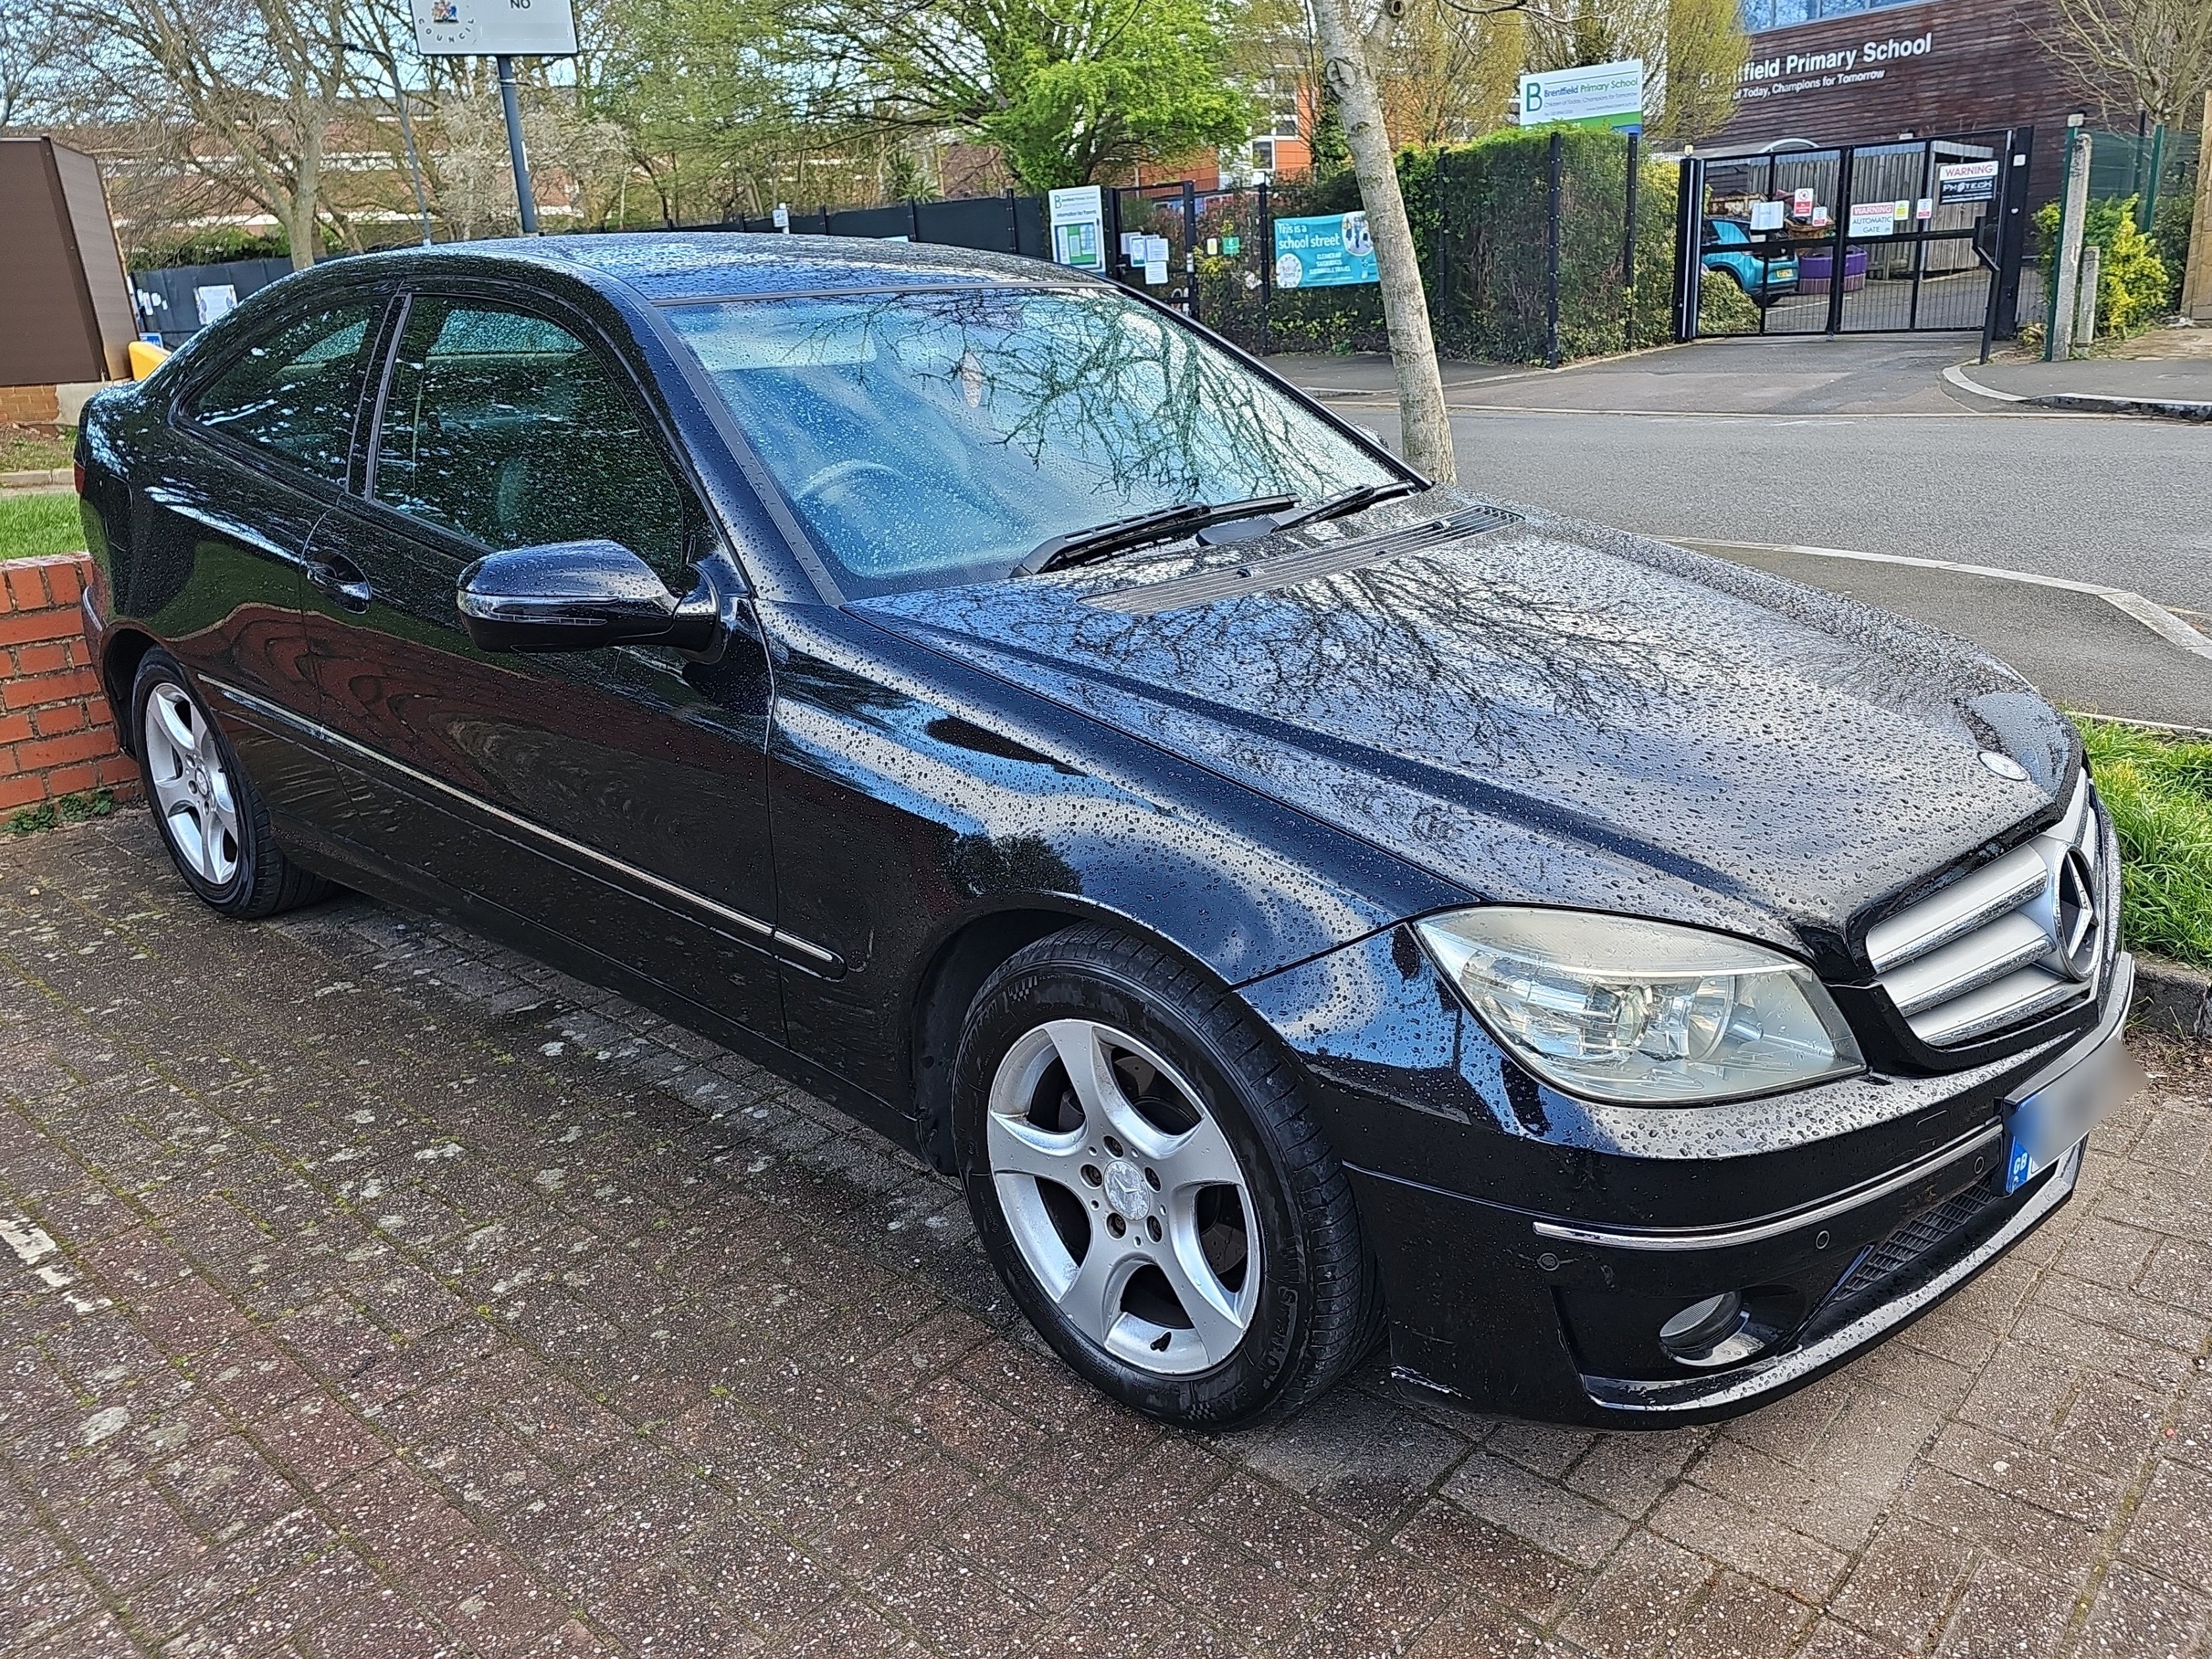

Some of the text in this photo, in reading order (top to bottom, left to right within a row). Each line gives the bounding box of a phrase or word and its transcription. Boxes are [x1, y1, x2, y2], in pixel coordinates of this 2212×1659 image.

[509, 0, 531, 9] NO
[418, 18, 475, 43] COUNCIL
[1786, 49, 1857, 74] Primary
[1863, 32, 1933, 63] School
[1733, 88, 1742, 100] of
[1743, 86, 1771, 100] Today,
[1772, 79, 1821, 94] Champions
[1822, 76, 1836, 88] for
[1837, 69, 1886, 85] Tomorrow
[1526, 77, 1638, 112] B Brentfield Primary School
[1946, 165, 1993, 177] WARNING
[1853, 205, 1892, 215] WARNING
[1277, 223, 1293, 233] This
[1293, 224, 1301, 233] is
[1278, 233, 1341, 250] school street
[2014, 1153, 2027, 1175] GB
